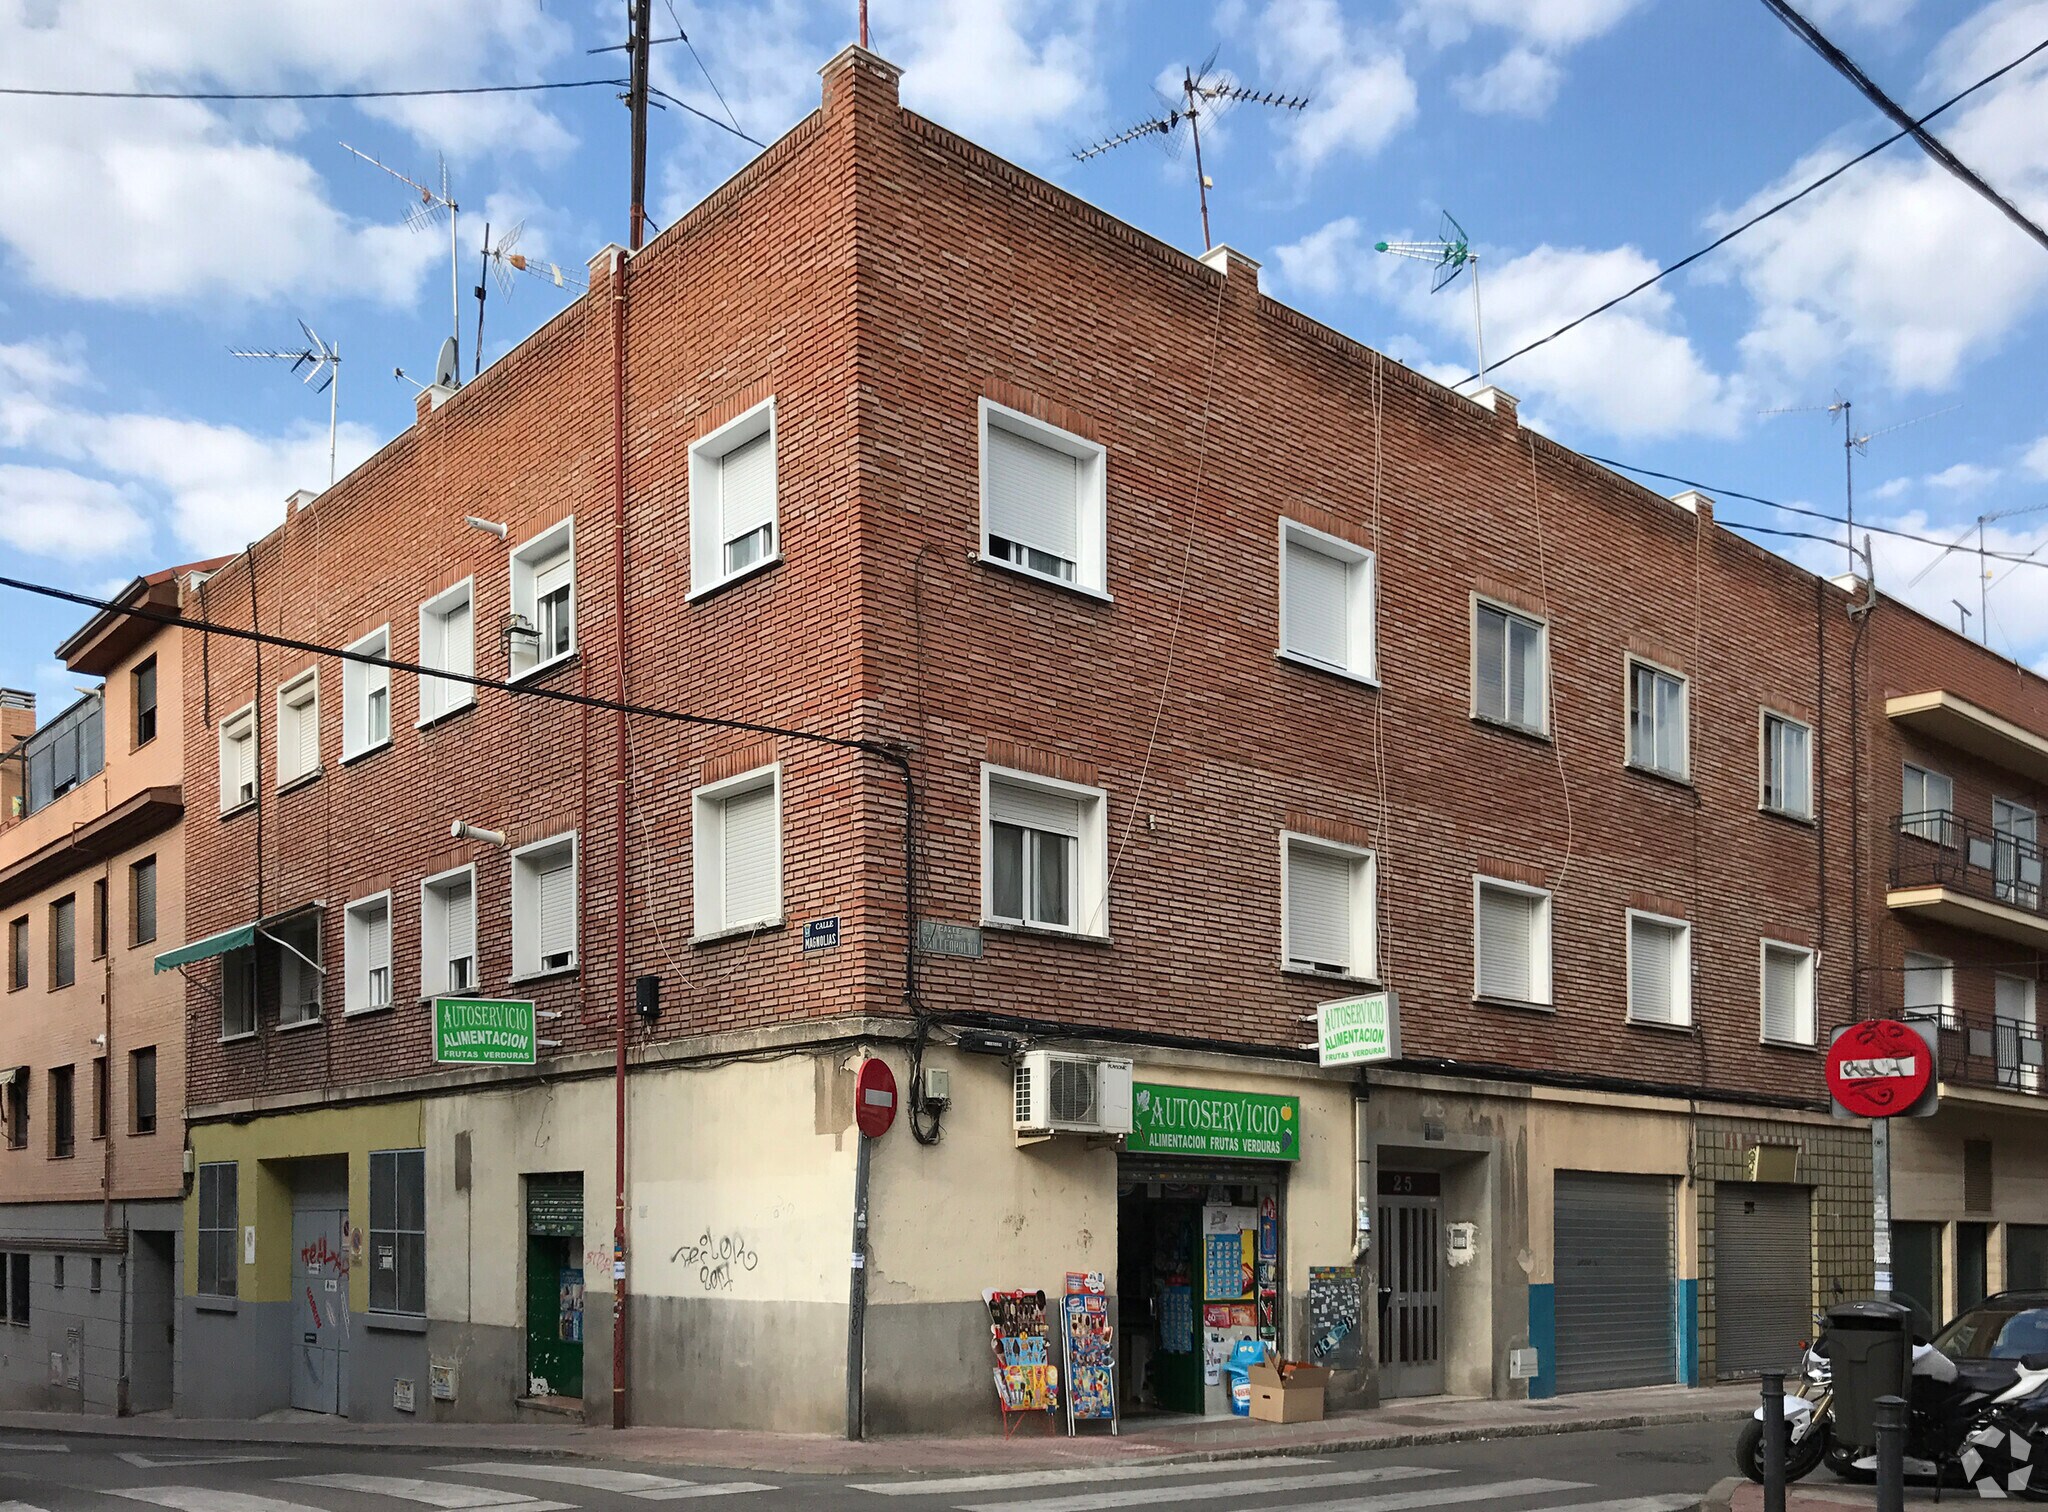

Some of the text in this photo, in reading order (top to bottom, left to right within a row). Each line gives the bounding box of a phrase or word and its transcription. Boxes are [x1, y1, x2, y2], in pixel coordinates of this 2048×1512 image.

[815, 920, 834, 930] CALLE
[940, 925, 963, 935] CALLE
[805, 933, 837, 949] MAGNOLIAS
[922, 937, 978, 955] SAN LEOPOLDO
[443, 1005, 528, 1031] AUTOSERVICIO
[1325, 1000, 1384, 1033] AUTOSERVICIO
[443, 1030, 528, 1050] ALIMENTACION
[1324, 1028, 1385, 1051] ALIMENTACION
[444, 1050, 530, 1060] FRUTAS VERDURAS
[1325, 1046, 1386, 1061] FRUTAS VERDURAS
[1150, 1097, 1280, 1134] AUTOSERVICIO
[1149, 1133, 1280, 1154] ALIMENTACION FRUTAS VERDURAS
[1393, 1174, 1411, 1192] 25
